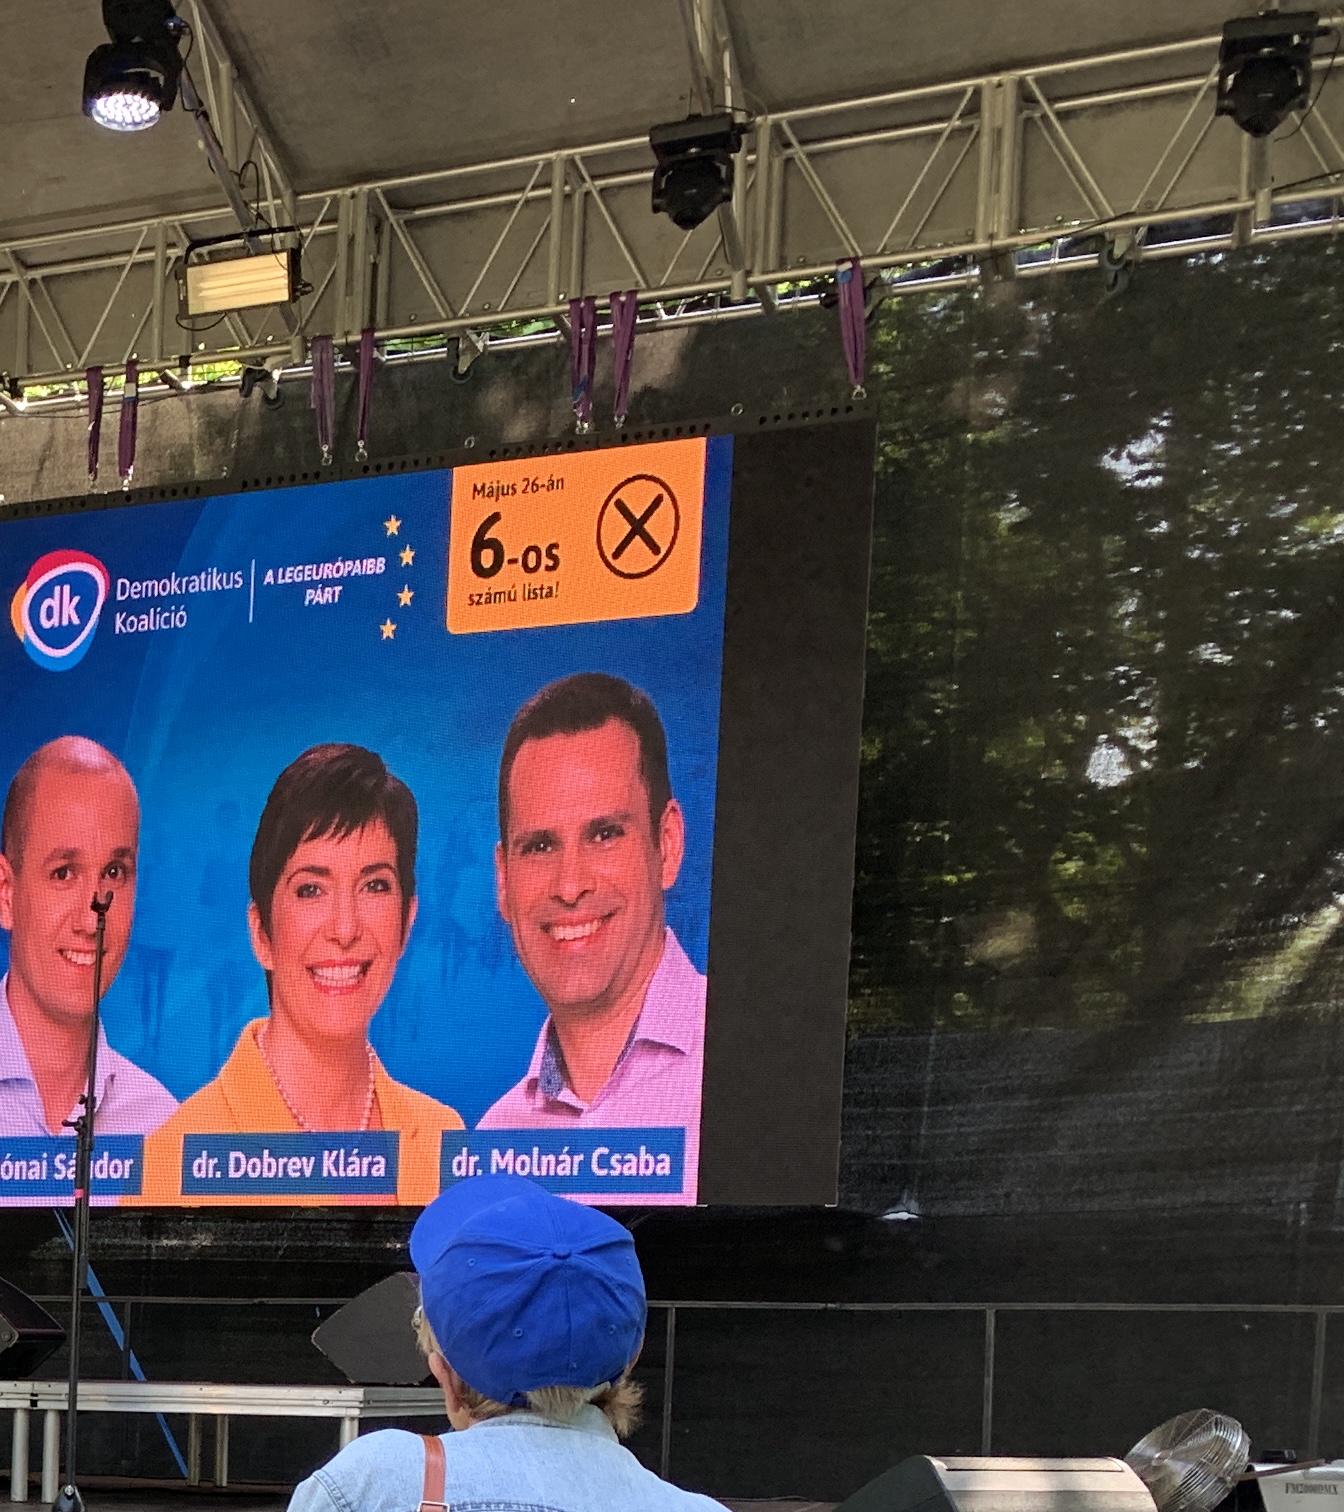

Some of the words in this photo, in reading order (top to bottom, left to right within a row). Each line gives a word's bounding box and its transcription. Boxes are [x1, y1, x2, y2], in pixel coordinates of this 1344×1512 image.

[472, 482, 517, 501] Május
[522, 474, 564, 494] 26-án
[470, 511, 560, 579] 6-os
[116, 566, 244, 601] Demokratikus
[263, 569, 274, 585] A
[277, 556, 386, 584] LEGEURÓPAIBB
[39, 584, 81, 629] dk
[304, 584, 343, 606] PÁRT
[468, 582, 517, 606] számú
[523, 581, 560, 601] lista!
[114, 605, 187, 635] Koalíció
[53, 1152, 134, 1180] Sádor
[192, 1150, 222, 1179] dr.
[228, 1149, 315, 1179] Dobrev
[322, 1148, 386, 1178] Klára
[451, 1147, 483, 1177] dr.
[490, 1146, 584, 1176] Molnár
[590, 1145, 671, 1176] Csaba
